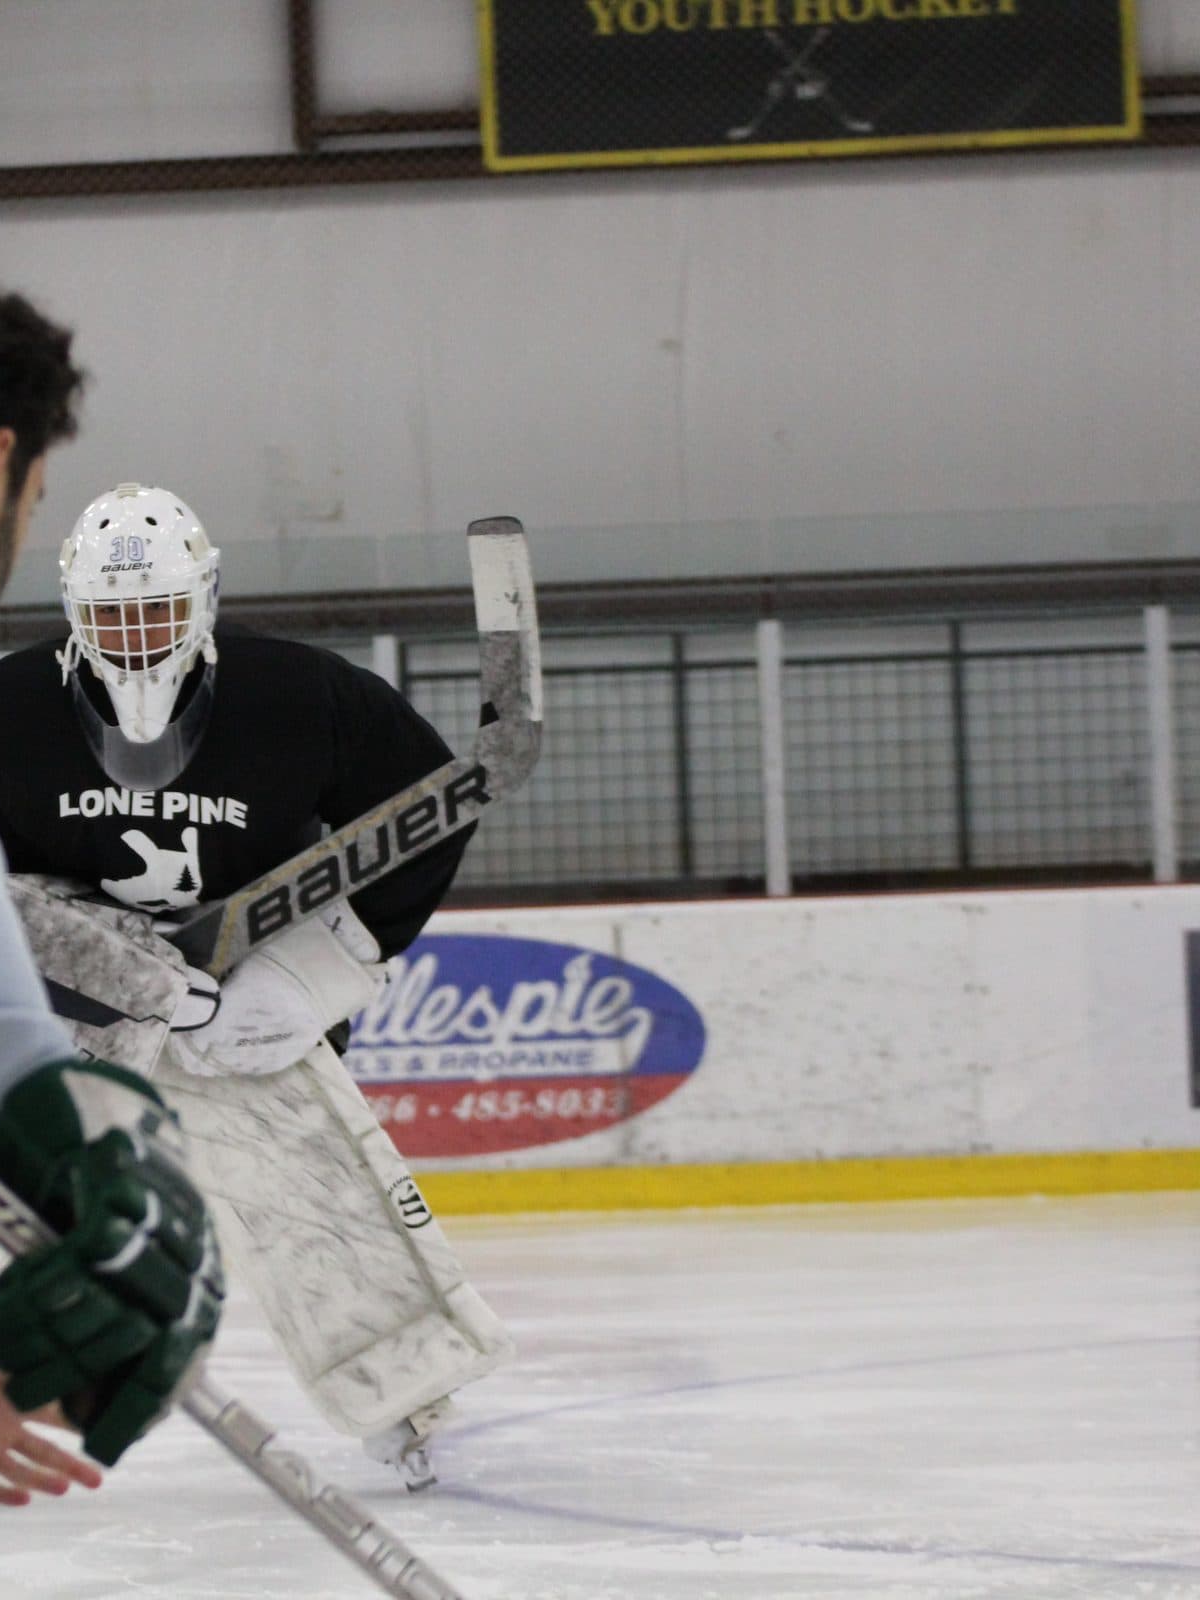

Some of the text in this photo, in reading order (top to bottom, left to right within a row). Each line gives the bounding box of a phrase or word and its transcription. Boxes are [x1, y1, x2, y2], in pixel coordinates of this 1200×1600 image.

[587, 0, 778, 36] YOUTH
[109, 535, 145, 562] 30
[58, 786, 249, 830] LONE PINE
[438, 1048, 595, 1072] PROPANE
